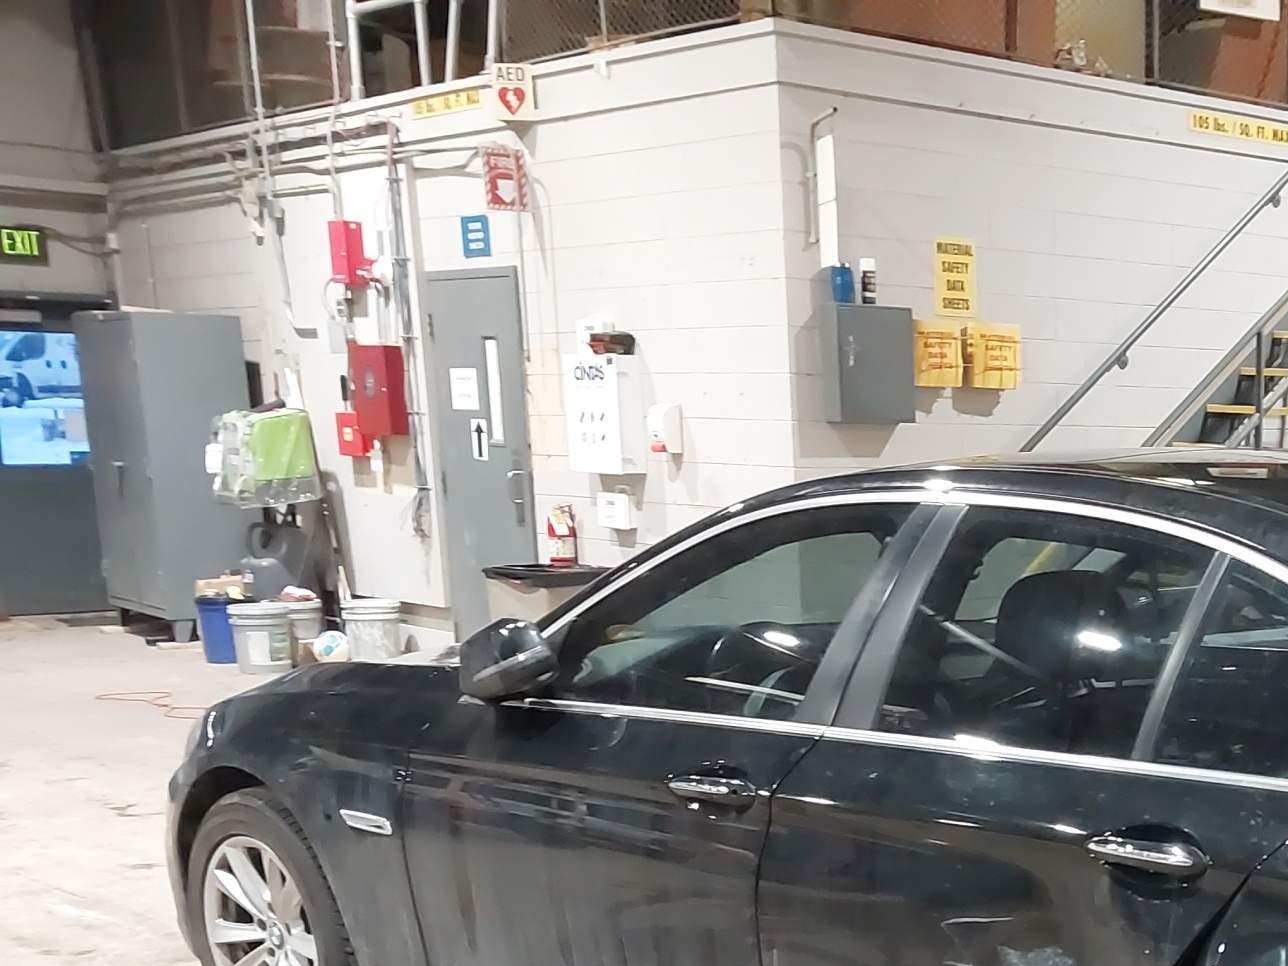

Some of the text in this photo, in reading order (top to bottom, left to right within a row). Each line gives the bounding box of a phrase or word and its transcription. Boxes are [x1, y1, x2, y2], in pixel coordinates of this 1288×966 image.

[496, 66, 525, 81] AED
[1193, 114, 1210, 130] 105
[1, 229, 40, 256] EXIT
[936, 242, 973, 257] MATERIAL
[941, 260, 969, 275] SAFETY
[946, 279, 966, 292] DATA
[942, 297, 970, 311] SHEETS
